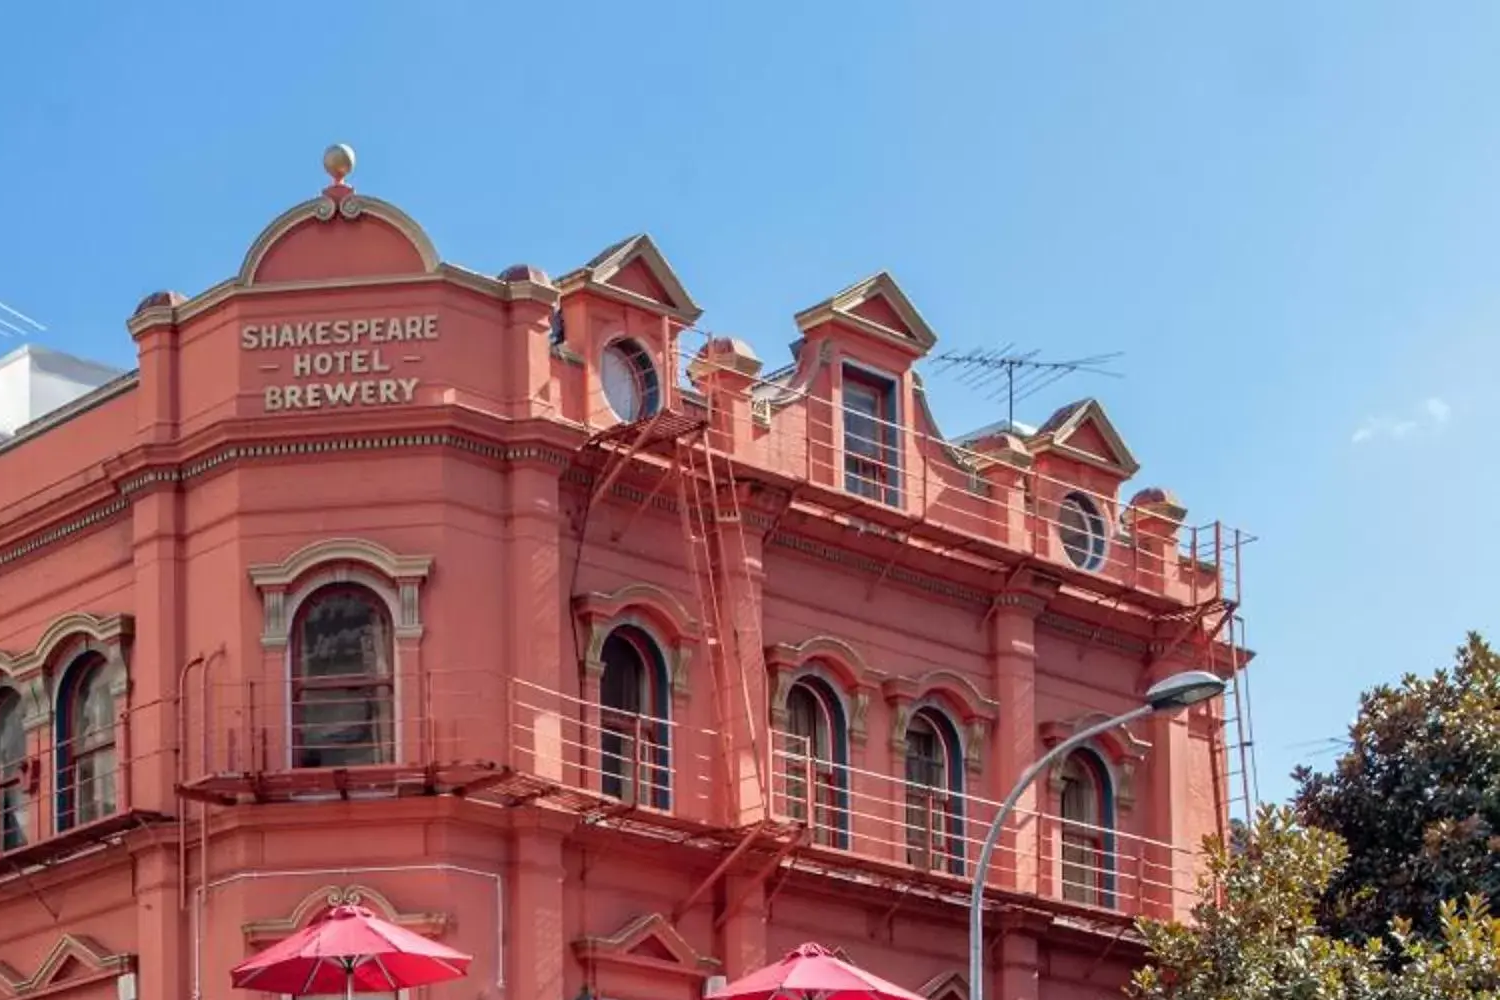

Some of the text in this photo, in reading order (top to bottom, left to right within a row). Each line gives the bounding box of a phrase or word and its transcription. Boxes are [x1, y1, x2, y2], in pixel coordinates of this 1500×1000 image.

[241, 315, 440, 350] SHAKESPEARE
[293, 350, 391, 378] HOTEL
[264, 378, 420, 412] BREWERY
